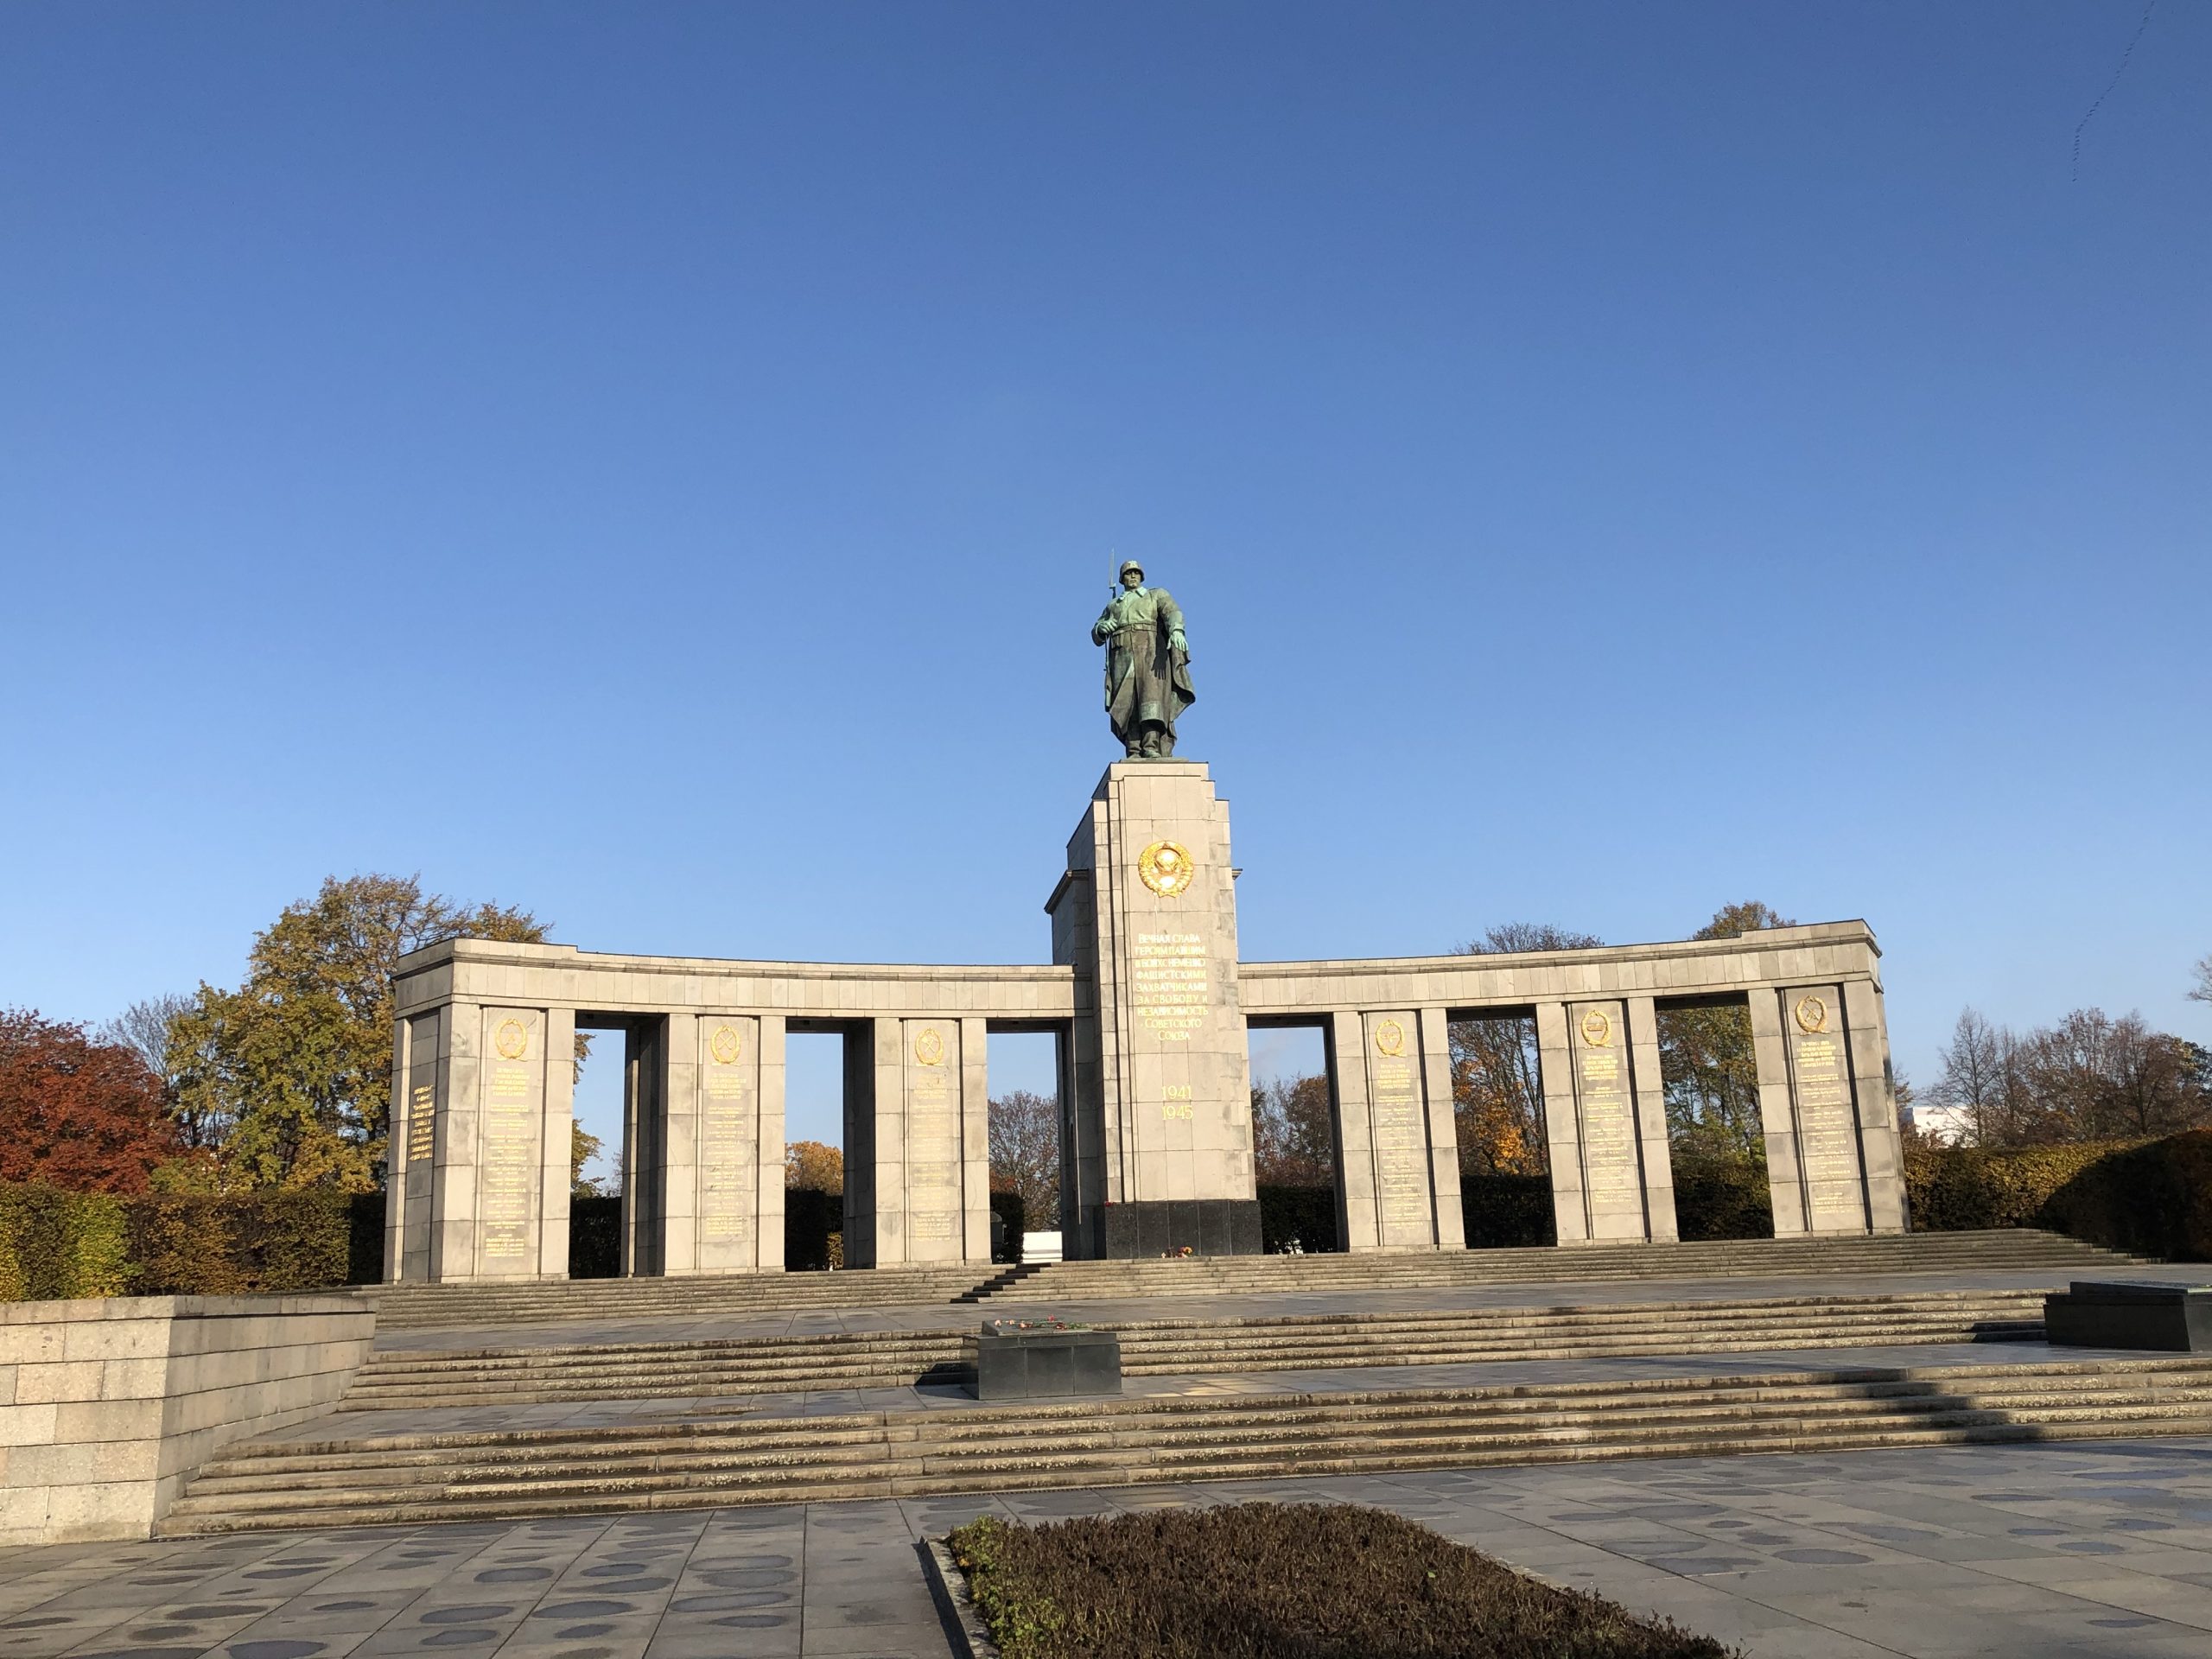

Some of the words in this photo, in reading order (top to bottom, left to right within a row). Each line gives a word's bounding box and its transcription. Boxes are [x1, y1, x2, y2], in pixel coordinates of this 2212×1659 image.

[1138, 995, 1150, 1004] ЗА
[1153, 995, 1198, 1003] СВОБОДУ
[1161, 1085, 1192, 1100] 1941
[1161, 1106, 1194, 1120] 1945
